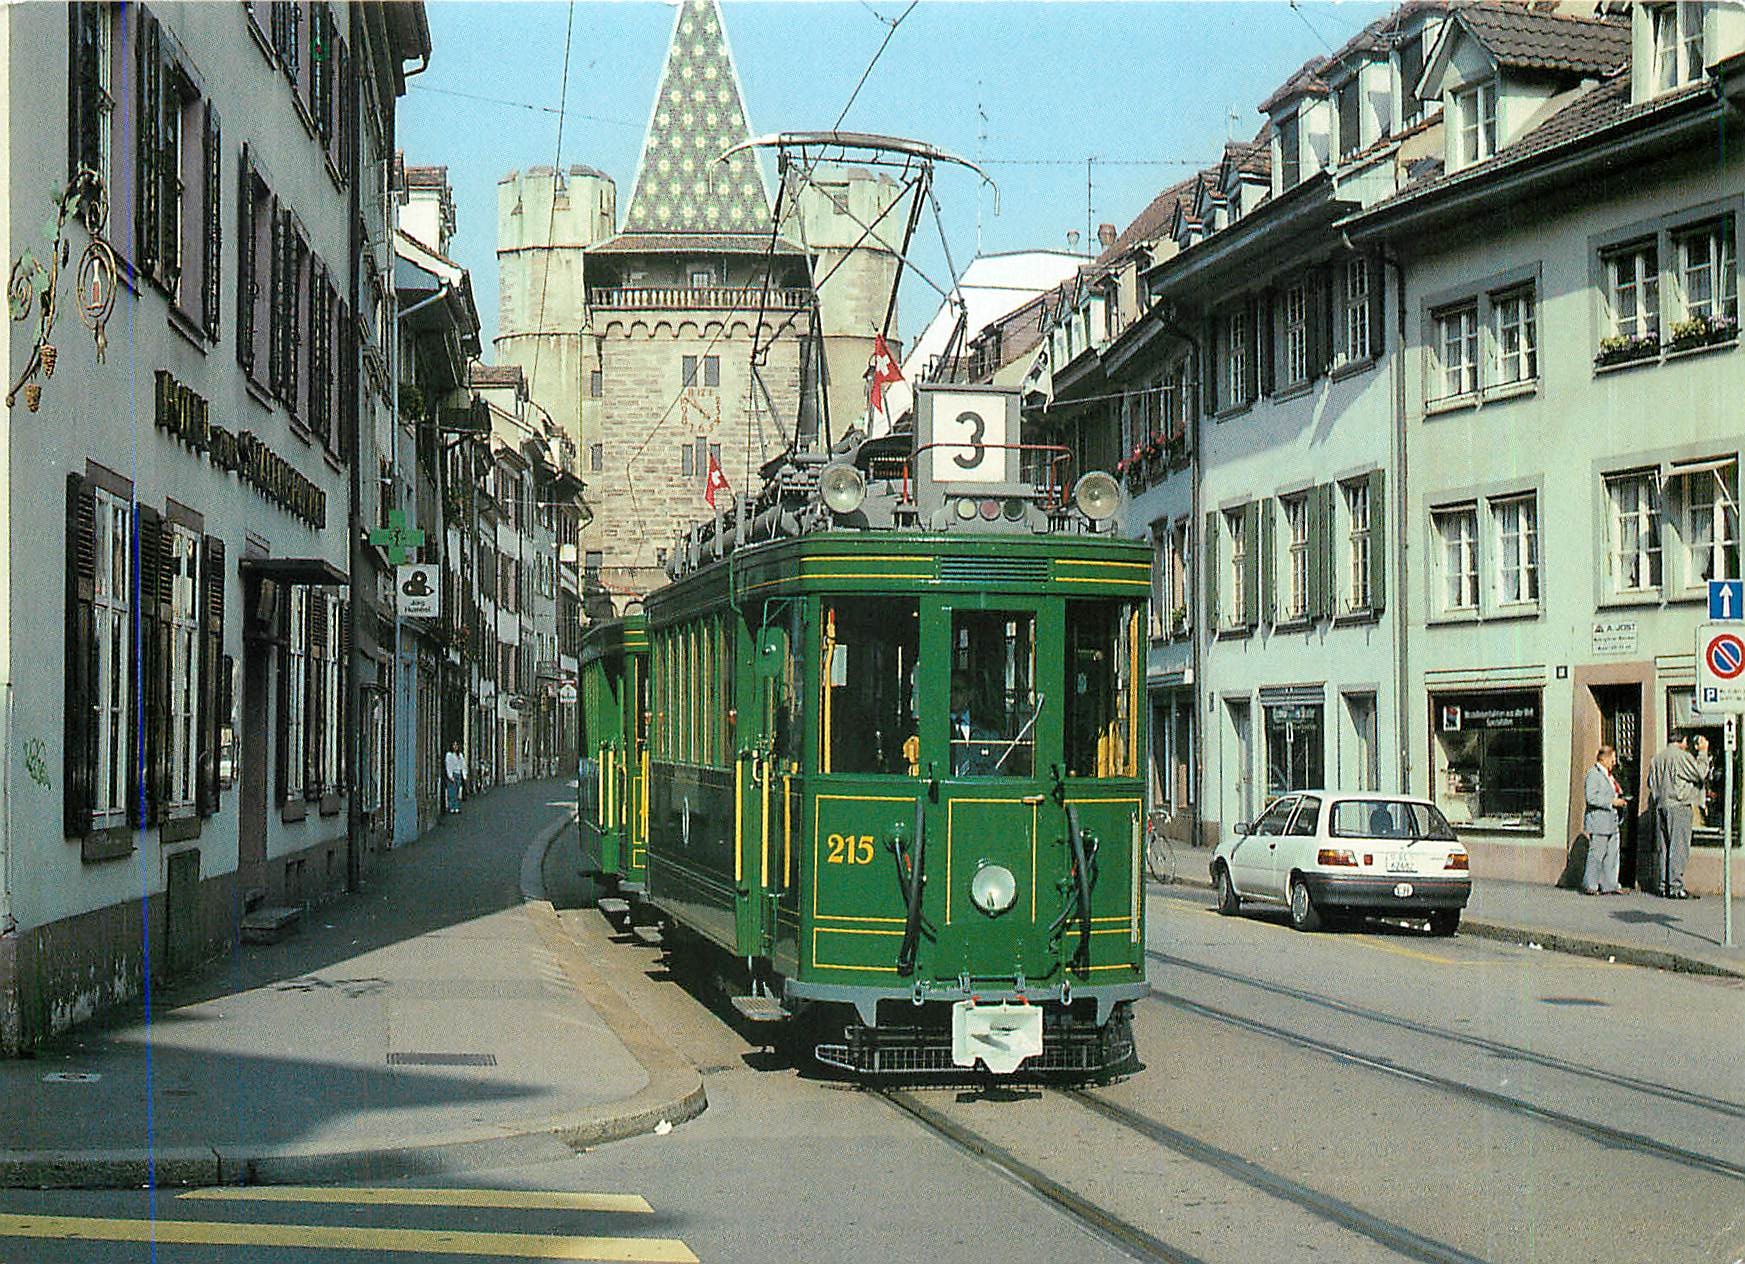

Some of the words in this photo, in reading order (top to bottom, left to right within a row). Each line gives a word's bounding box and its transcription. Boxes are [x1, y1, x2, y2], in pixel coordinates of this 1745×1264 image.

[952, 411, 985, 470] 3
[1706, 689, 1716, 702] P
[828, 833, 874, 865] 215
